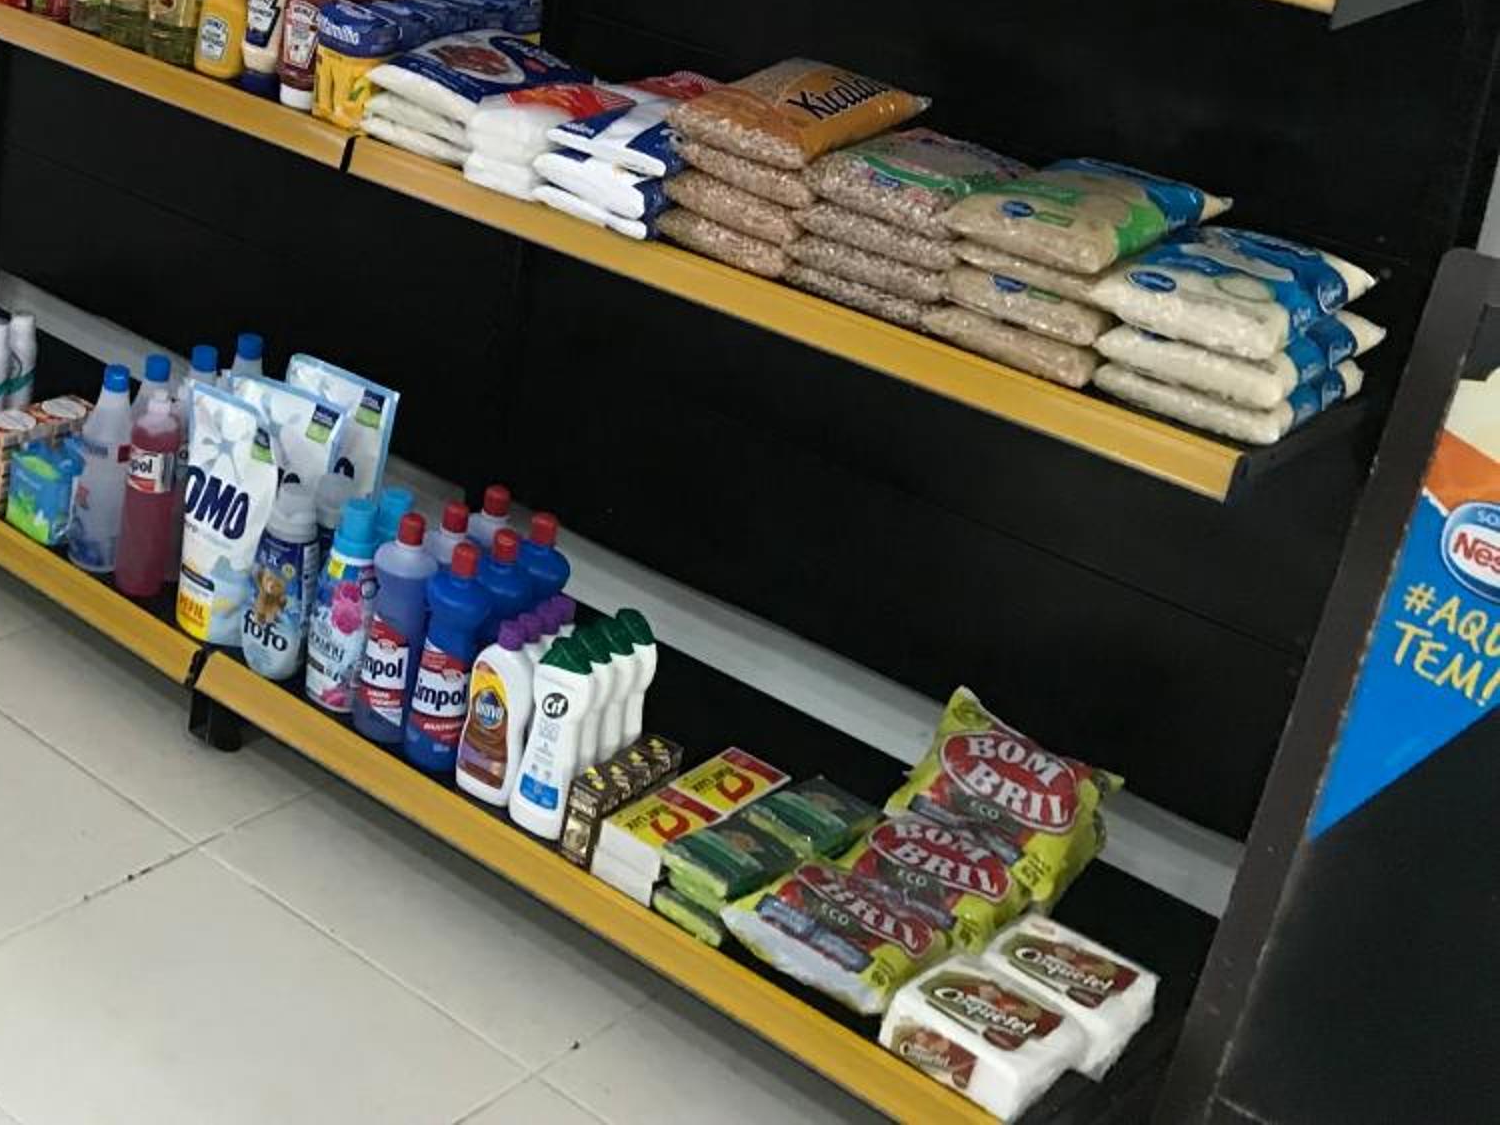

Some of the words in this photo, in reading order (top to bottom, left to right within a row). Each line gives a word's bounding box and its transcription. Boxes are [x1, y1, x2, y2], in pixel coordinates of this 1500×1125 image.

[184, 464, 249, 540] OMO
[243, 608, 288, 652] fofo
[414, 677, 467, 711] impol
[543, 695, 567, 714] Cif
[965, 735, 1066, 788] BOM
[962, 762, 1071, 825] BRIL
[969, 800, 1000, 820] ECO
[896, 824, 996, 865] BOM
[892, 843, 1002, 898] BRIL
[819, 904, 850, 926] ECO
[823, 882, 921, 950] BRIL
